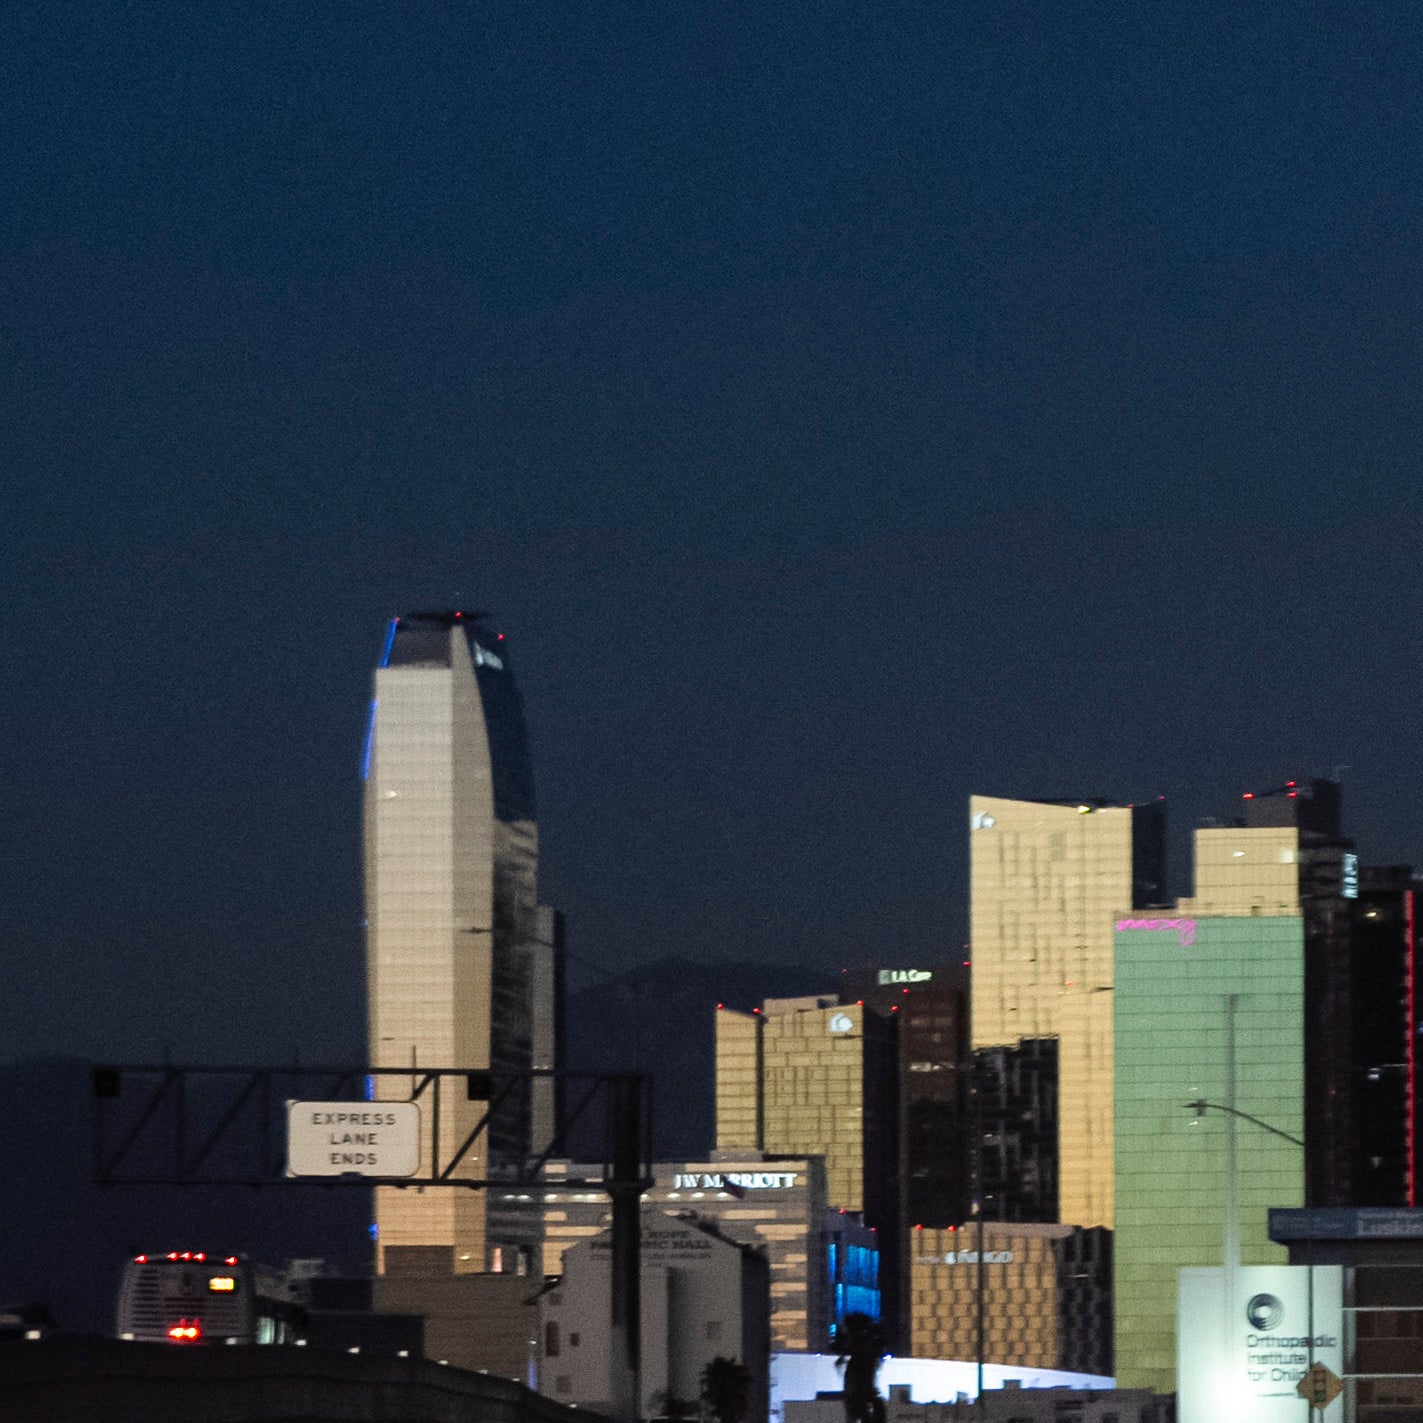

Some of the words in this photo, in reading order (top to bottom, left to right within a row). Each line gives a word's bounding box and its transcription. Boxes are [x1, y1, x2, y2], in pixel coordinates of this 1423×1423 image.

[312, 1112, 396, 1126] EXPRESS
[330, 1133, 378, 1146] LANE
[330, 1152, 378, 1165] ENDS
[674, 1174, 702, 1190] JW
[1357, 1220, 1423, 1237] Luskin
